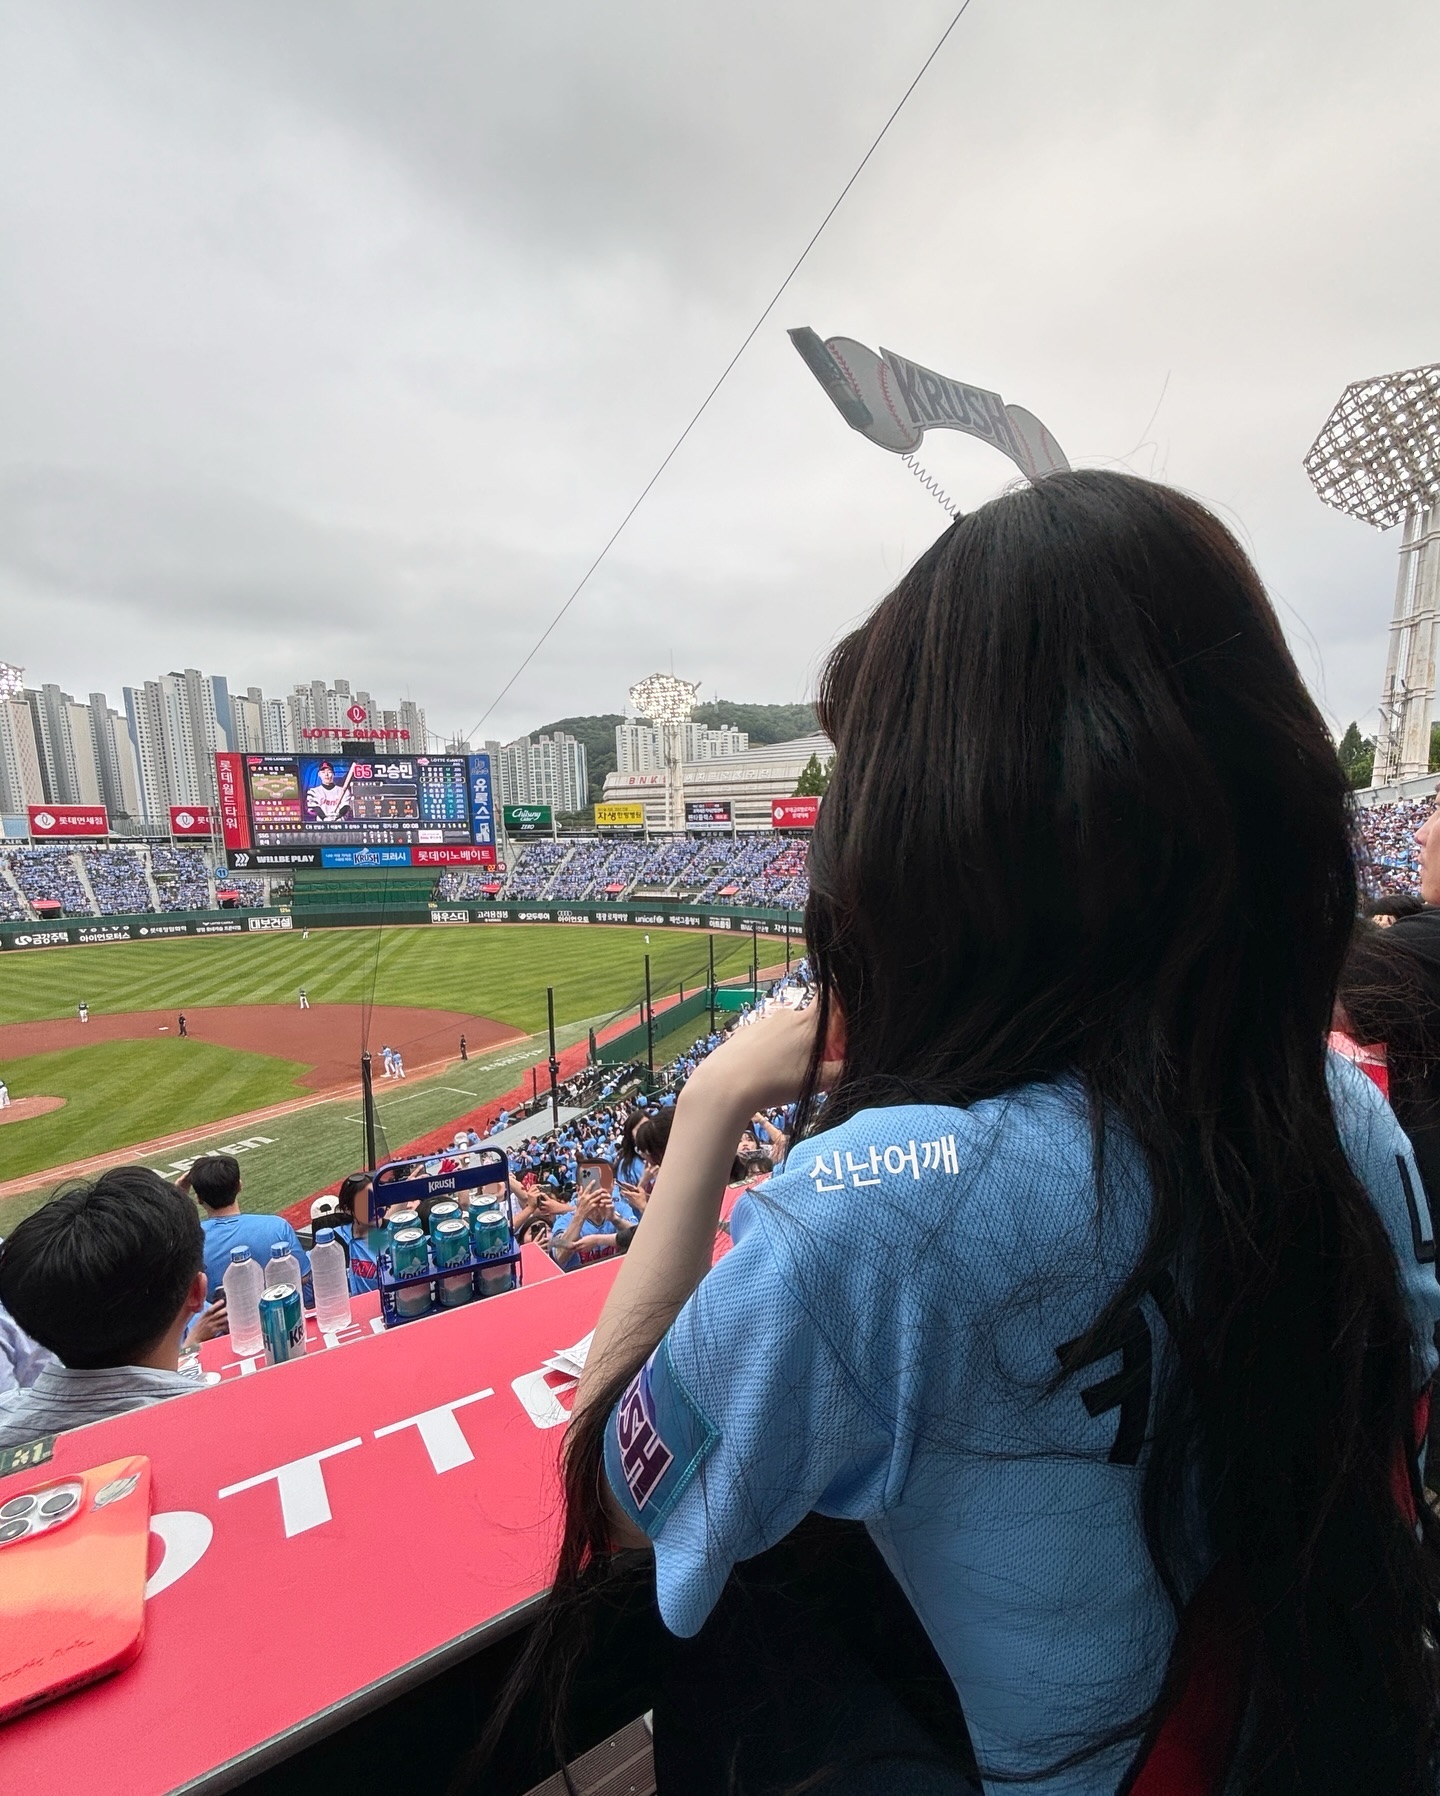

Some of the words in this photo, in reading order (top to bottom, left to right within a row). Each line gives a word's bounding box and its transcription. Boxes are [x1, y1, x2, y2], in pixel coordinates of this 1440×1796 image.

[886, 353, 1024, 458] KRUSH
[302, 728, 350, 739] LOTTE
[353, 728, 410, 740] GIANTS
[354, 764, 373, 779] 65
[374, 764, 413, 779] 고승민
[220, 760, 238, 829] 롯데월드타워
[256, 855, 290, 864] WILLBE
[291, 855, 315, 863] PLAY
[353, 852, 380, 865] KRUSH
[382, 852, 406, 861] 크러시
[418, 850, 491, 862] 롯데이노베이트
[250, 917, 291, 929] 대보건설
[635, 915, 657, 924] unicef
[79, 925, 130, 933] VOLVO
[31, 932, 69, 945] 금강주택
[79, 932, 131, 942] 아이언모터스
[809, 1134, 959, 1192] 신난어깨
[428, 1177, 456, 1193] KRUSH
